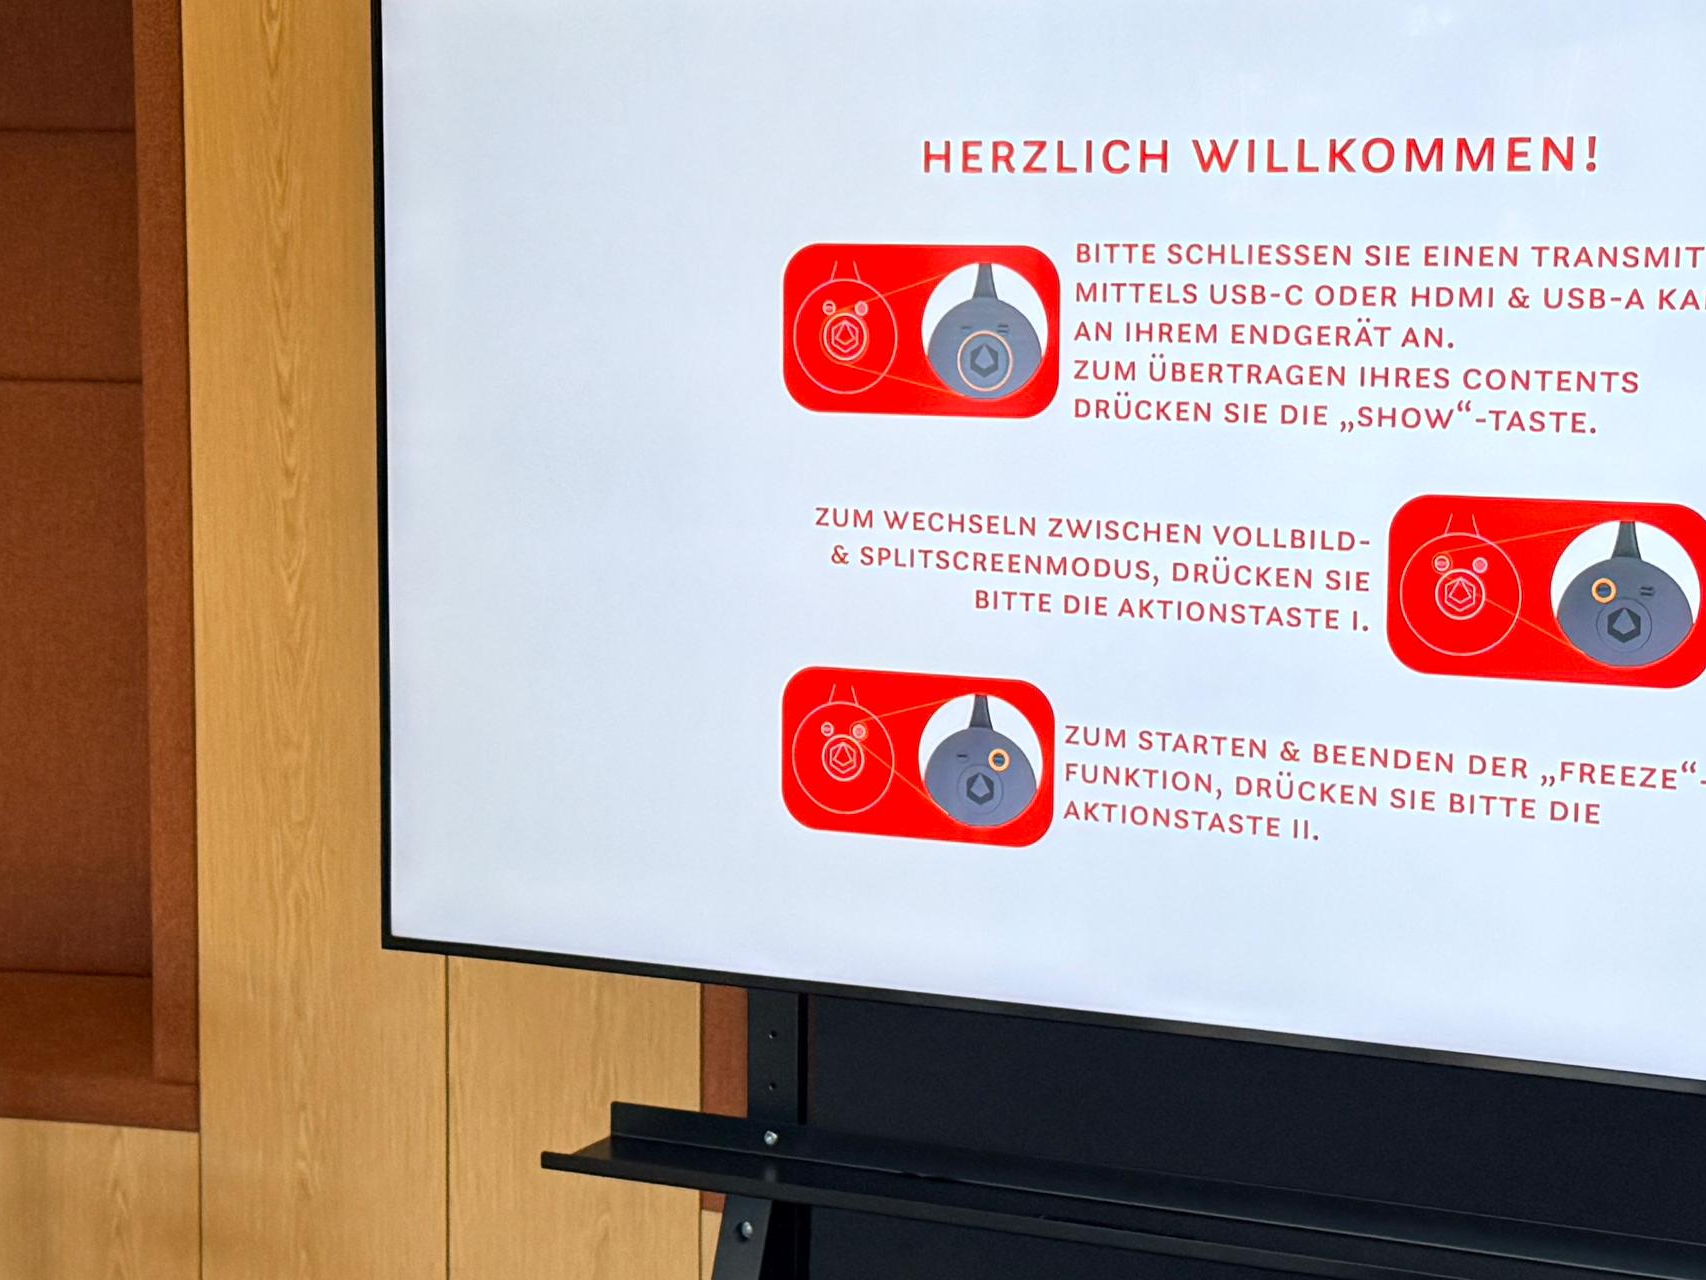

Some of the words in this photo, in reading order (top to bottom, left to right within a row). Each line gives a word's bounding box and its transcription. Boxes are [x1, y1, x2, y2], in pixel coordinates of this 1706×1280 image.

[923, 139, 1169, 174] HERZLICH
[1192, 136, 1597, 173] WILLKOMMEN!
[1076, 243, 1156, 264] BITTE
[1167, 243, 1351, 266] SCHLIESSEN
[1364, 244, 1410, 266] SIE
[1424, 245, 1519, 267] EINEN
[1075, 283, 1198, 304] MITTELS
[1210, 284, 1303, 306] USB-C
[1315, 285, 1397, 307] ODER
[1411, 286, 1495, 309] HDMI
[1508, 288, 1530, 310] &
[1544, 288, 1645, 310] USB-A
[1074, 322, 1113, 342] AN
[1126, 322, 1217, 344] IHREM
[1231, 318, 1391, 347] ENDGERÄT
[1401, 327, 1454, 348] AN.
[1074, 360, 1136, 382] ZUM
[1149, 354, 1346, 387] ÜBERTRAGEN
[1359, 366, 1450, 389] IHRES
[1463, 368, 1640, 393] CONTENTS
[1074, 392, 1212, 422] DRÜCKEN
[1224, 402, 1267, 424] SIE
[1280, 404, 1328, 425] DIE
[814, 506, 873, 529] ZUM
[884, 509, 1036, 536] WECHSELN
[1048, 517, 1201, 544] ZWISCHEN
[1213, 525, 1370, 551] VOLLBILD-
[831, 544, 849, 565] &
[860, 546, 1159, 585] SPLITSCREENMODUS,
[1172, 557, 1313, 589] DRÜCKEN
[1325, 569, 1370, 592] SIE
[976, 590, 1052, 613] BITTE
[1064, 594, 1107, 616] DIE
[1118, 597, 1339, 630] AKTIONSTASTE
[1352, 610, 1369, 631] I.
[1065, 725, 1126, 748] ZUM
[1138, 730, 1267, 759] STARTEN
[1280, 739, 1300, 761] &
[1313, 742, 1454, 773] BEENDEN
[1468, 754, 1527, 779] DER
[1065, 763, 1222, 799] FUNKTION,
[1235, 771, 1377, 807] DRÜCKEN
[1390, 788, 1435, 811] SIE
[1450, 793, 1536, 819] BITTE
[1550, 800, 1600, 824] DIE
[1064, 801, 1280, 837] AKTIONSTASTE
[1292, 819, 1319, 840] II.
